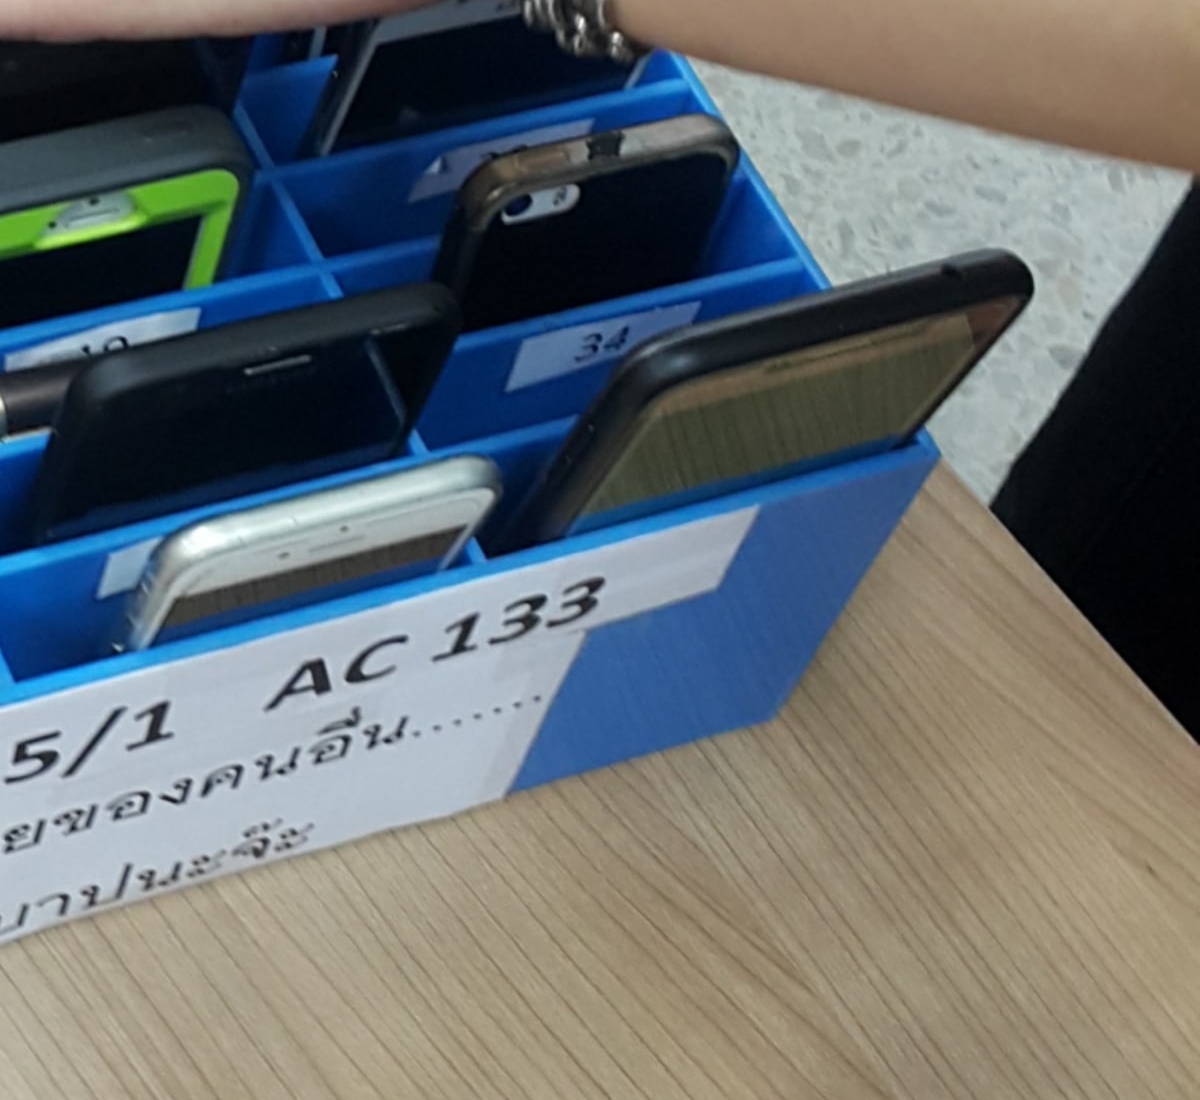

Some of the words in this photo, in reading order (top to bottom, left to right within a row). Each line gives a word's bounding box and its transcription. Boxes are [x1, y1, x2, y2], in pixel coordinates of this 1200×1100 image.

[573, 325, 629, 364] 34
[263, 636, 408, 711] AC
[430, 577, 607, 665] 133
